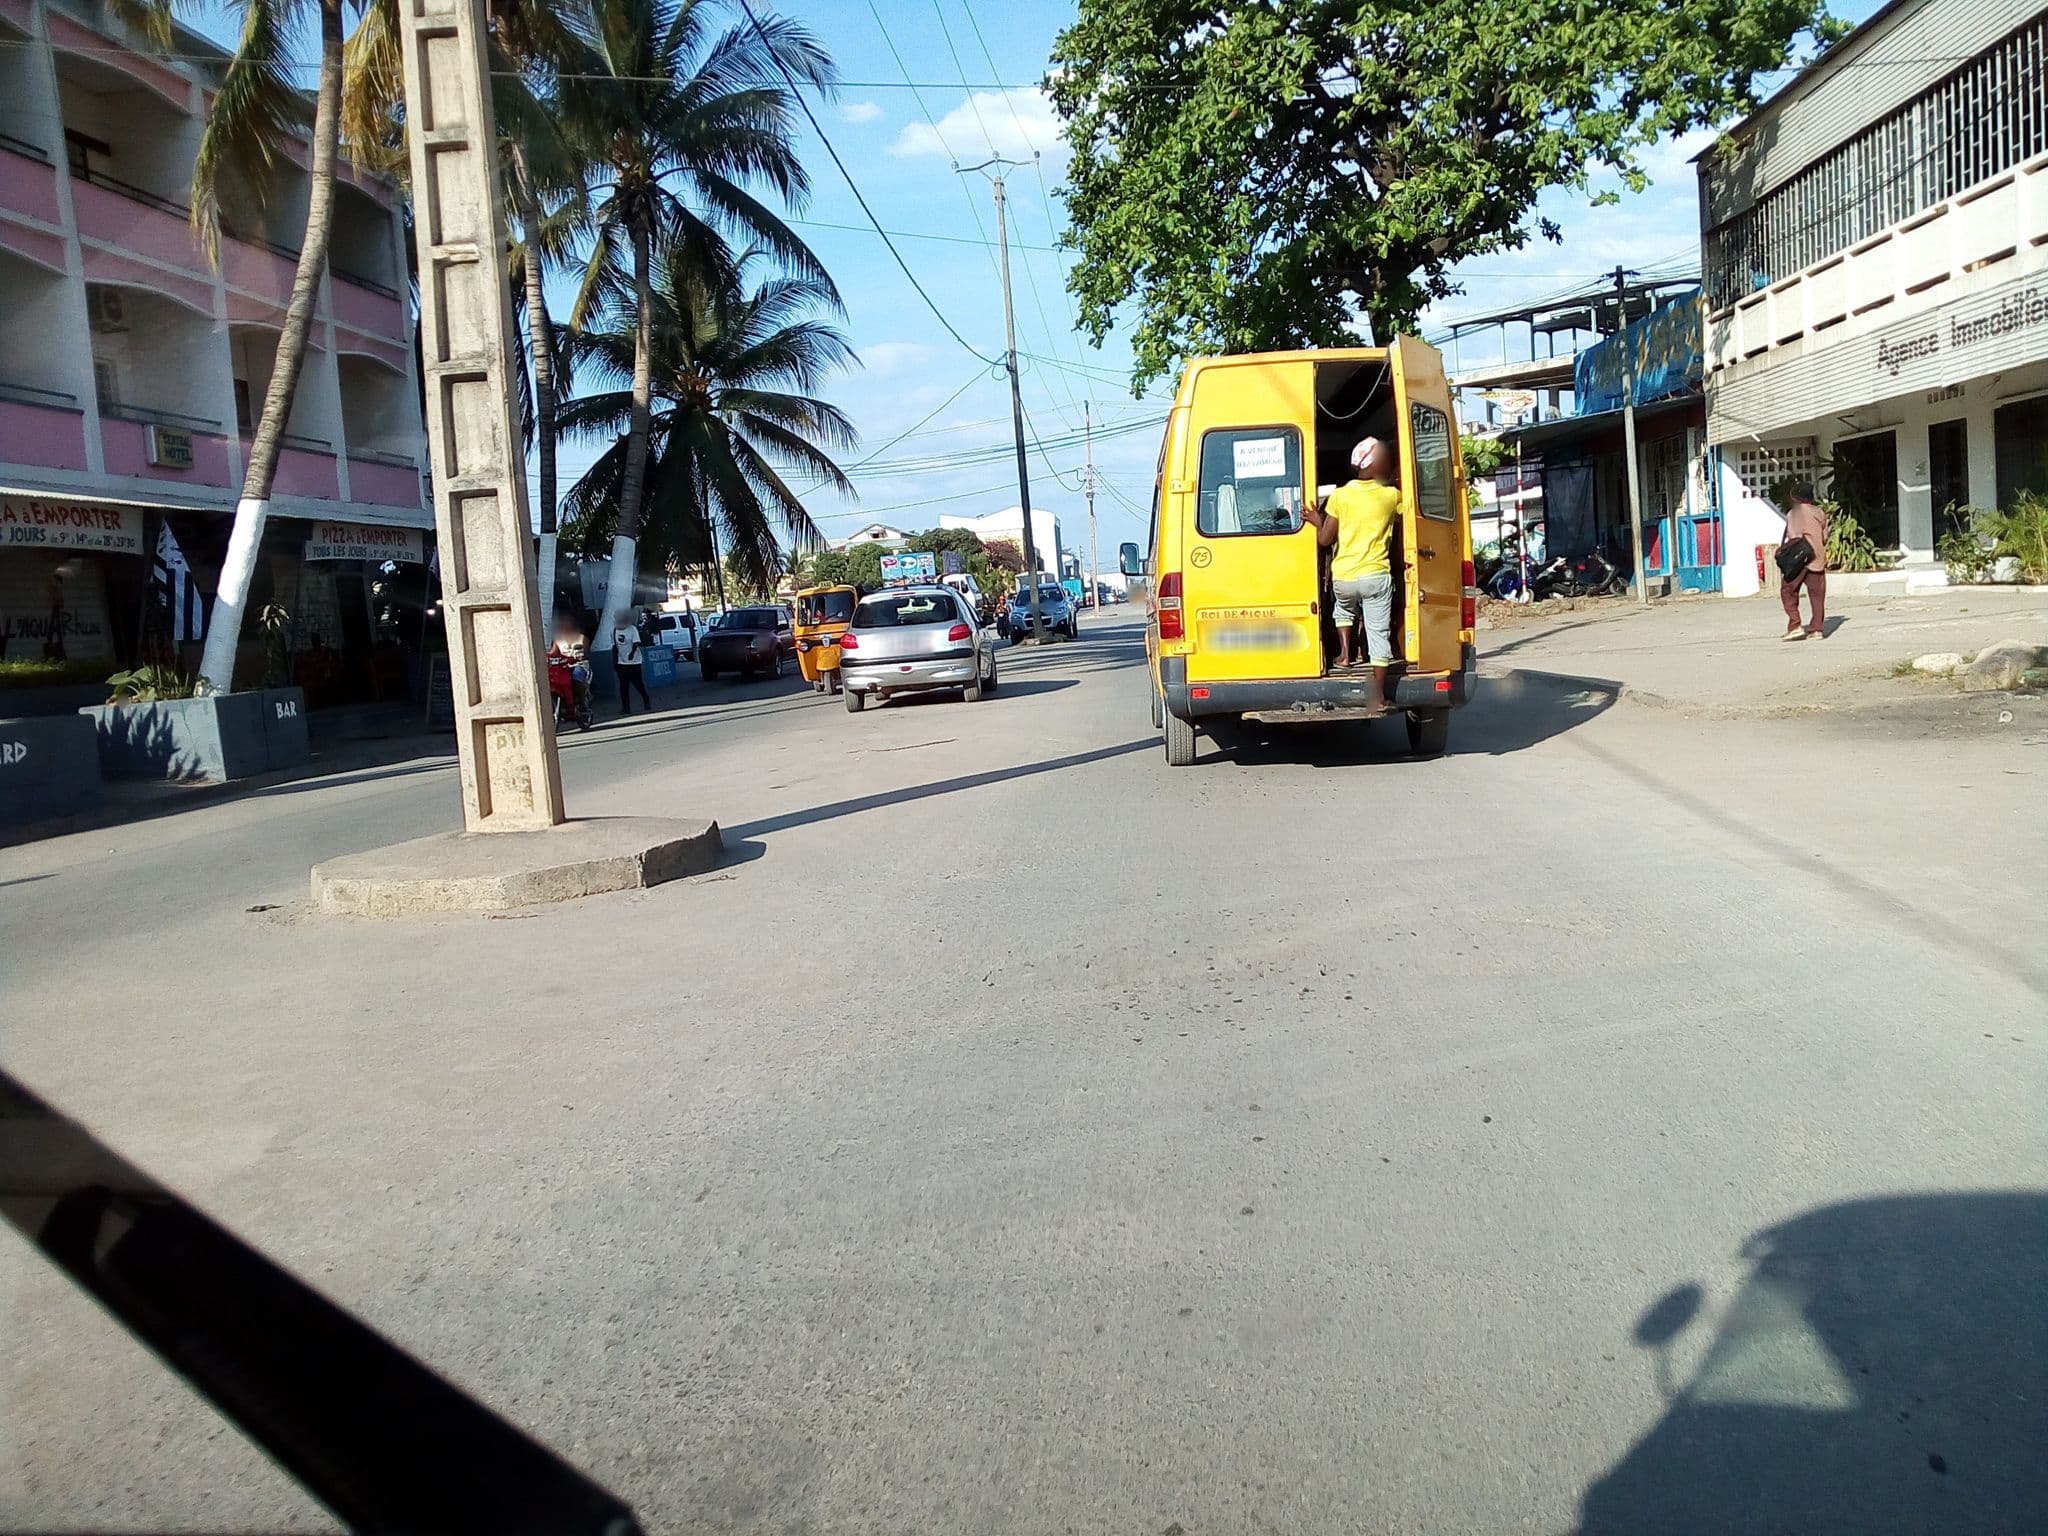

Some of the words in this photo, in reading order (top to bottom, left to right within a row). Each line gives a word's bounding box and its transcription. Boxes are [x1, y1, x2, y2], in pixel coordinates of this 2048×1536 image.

[1877, 333, 1939, 376] Agence
[164, 447, 192, 461] HOTEL
[30, 502, 121, 530] EMPORTER
[9, 527, 46, 543] JOURS
[322, 527, 354, 544] PIZZA
[360, 528, 408, 547] EMPORTER
[313, 545, 331, 558] TOUS
[333, 545, 346, 557] LES
[348, 546, 367, 558] JOURS
[1194, 551, 1208, 562] 75
[1201, 611, 1220, 620] ROI
[1224, 610, 1238, 619] DE
[276, 702, 297, 720] BAR
[0, 741, 27, 765] RD
